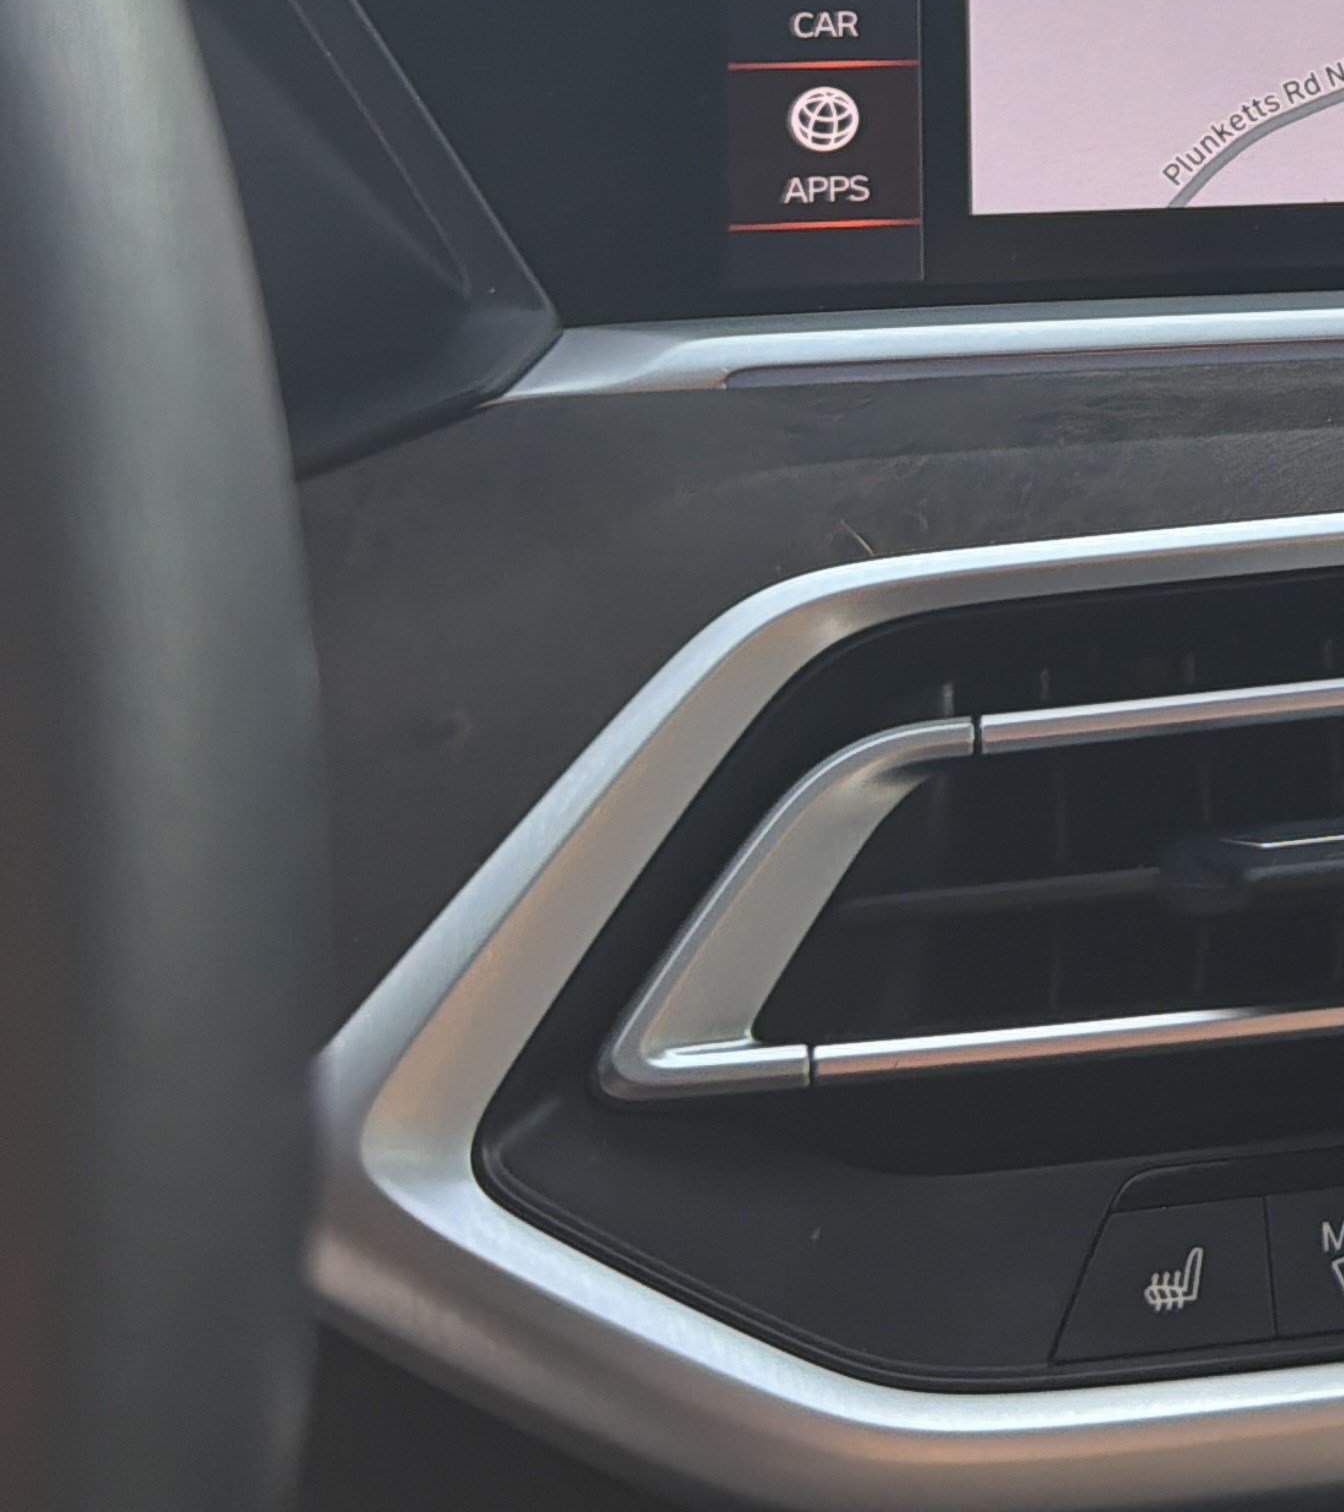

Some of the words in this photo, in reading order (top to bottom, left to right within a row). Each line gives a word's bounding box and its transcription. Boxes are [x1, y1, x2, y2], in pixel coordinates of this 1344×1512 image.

[793, 11, 858, 38] CAR
[1162, 94, 1282, 186] Plunketts
[1282, 71, 1321, 104] Rd
[783, 175, 870, 204] APPS
